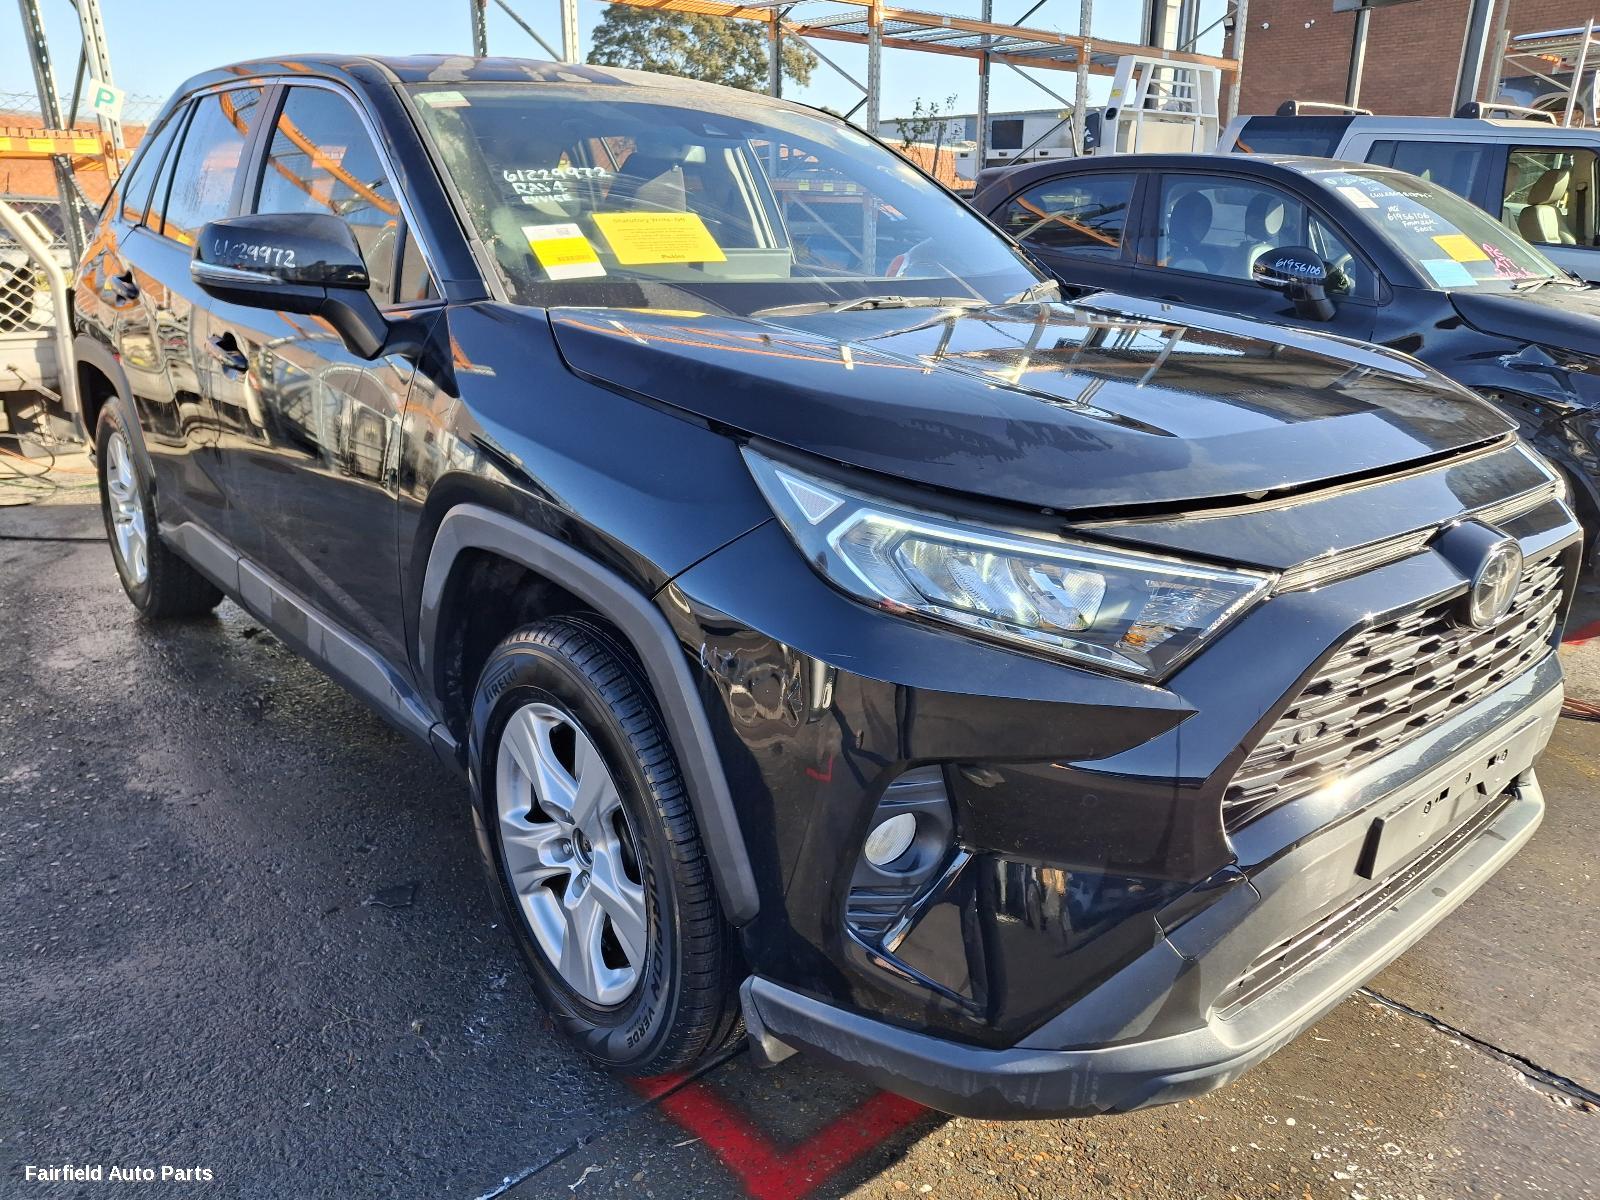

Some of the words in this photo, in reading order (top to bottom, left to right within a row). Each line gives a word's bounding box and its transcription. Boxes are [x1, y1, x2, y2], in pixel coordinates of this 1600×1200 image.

[95, 87, 116, 108] P
[503, 166, 612, 183] 61229972
[1275, 258, 1321, 275] 61956106
[636, 818, 663, 1001] CORPION
[626, 1007, 655, 1048] VERDE
